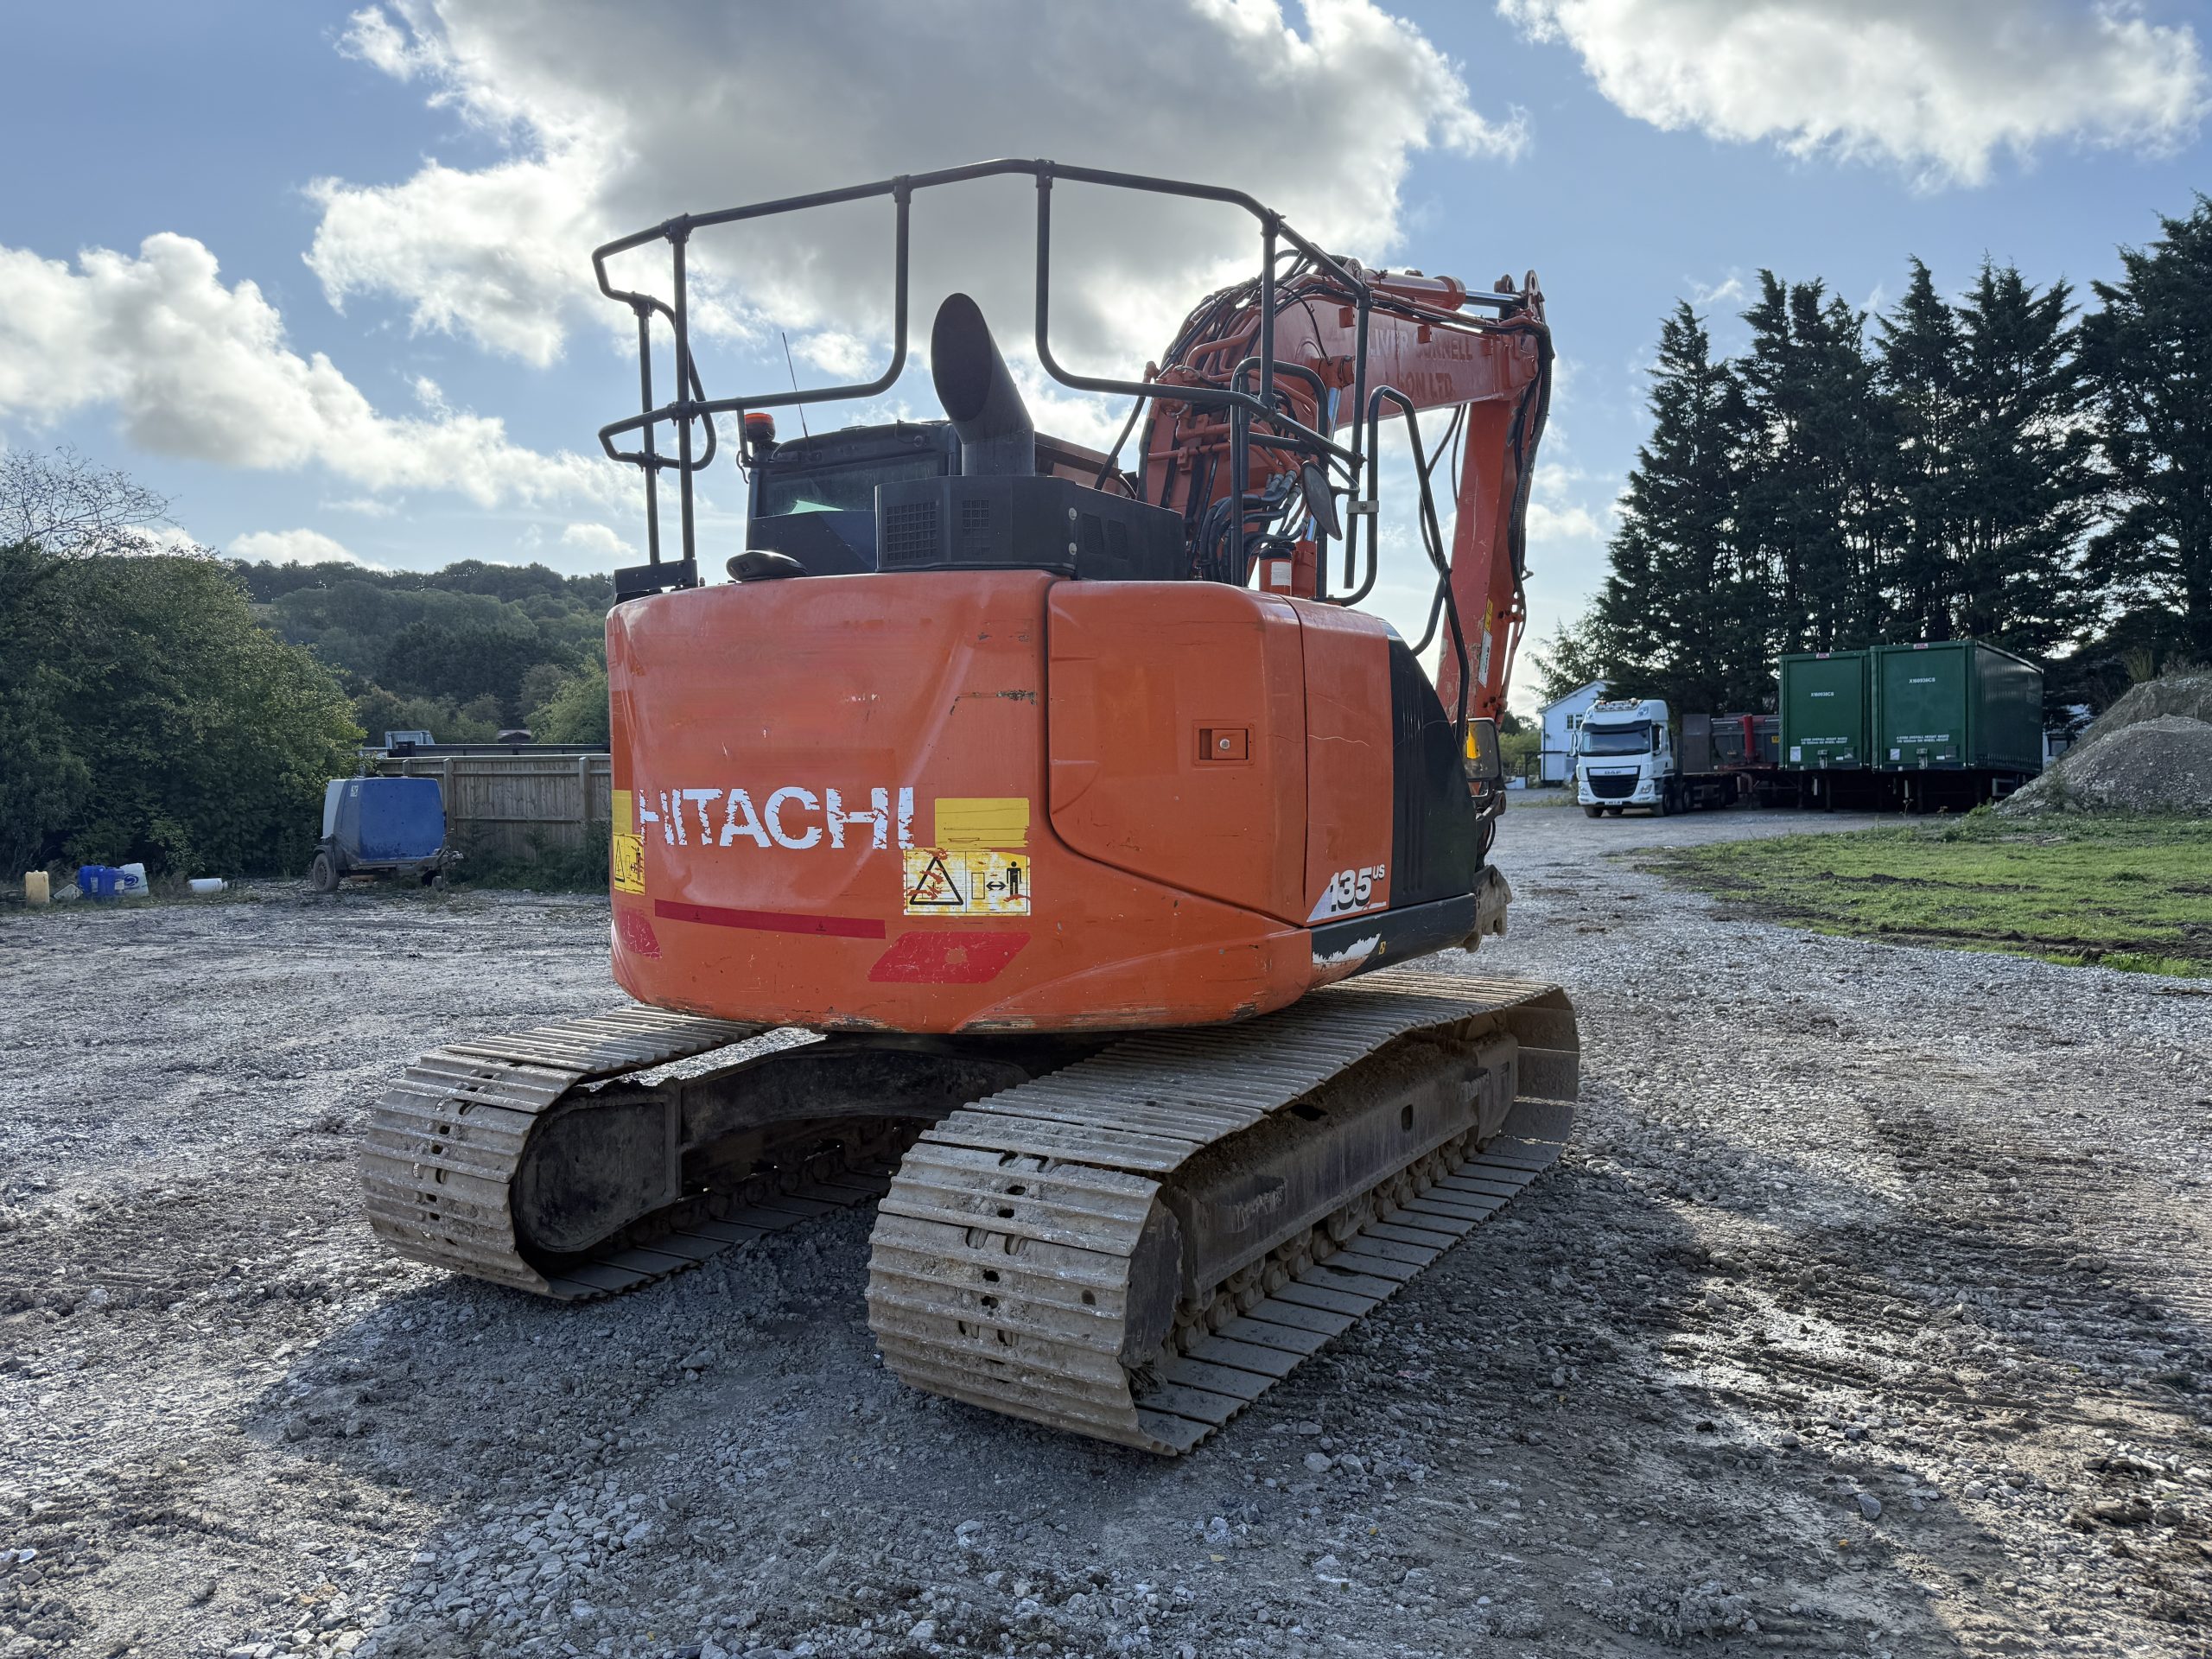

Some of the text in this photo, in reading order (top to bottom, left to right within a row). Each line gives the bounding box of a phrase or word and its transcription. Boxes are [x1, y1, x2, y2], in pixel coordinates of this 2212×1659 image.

[639, 785, 915, 850] HITACHI
[1330, 864, 1385, 912] 135 US
